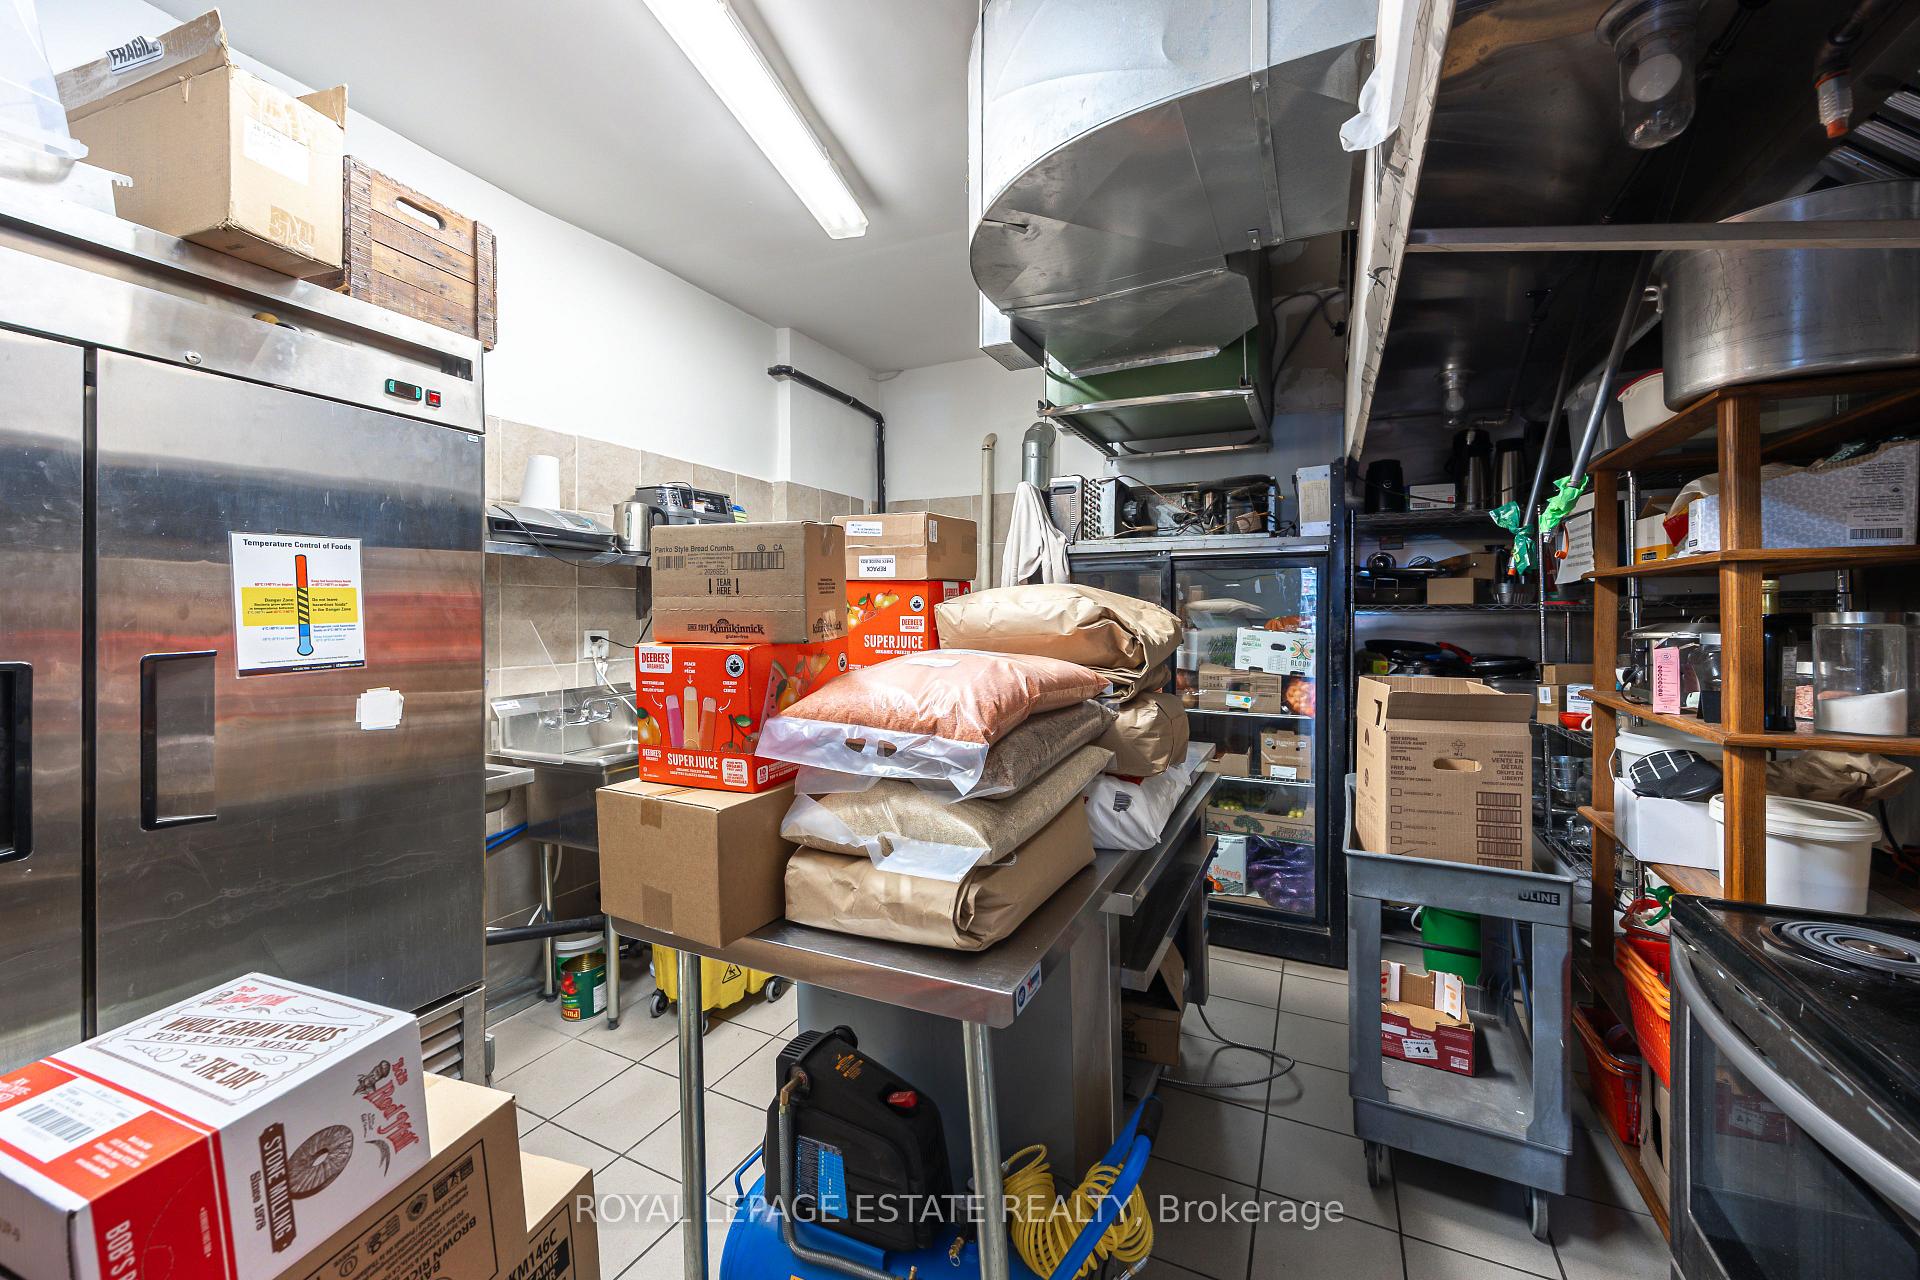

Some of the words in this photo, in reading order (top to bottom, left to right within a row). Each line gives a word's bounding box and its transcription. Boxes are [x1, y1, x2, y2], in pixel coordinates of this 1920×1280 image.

[243, 539, 292, 548] Temperature
[294, 541, 321, 549] Control
[322, 542, 330, 550] of
[674, 546, 689, 554] Style
[710, 544, 734, 552] Crumbs
[717, 578, 731, 586] TEAR
[717, 587, 731, 595] HERE
[710, 624, 764, 635] kinnikinnick
[864, 635, 923, 649] SUPERJUICE
[641, 652, 670, 664] DEEBEES
[667, 753, 719, 770] SUPERJUICE
[1521, 891, 1559, 904] ULINE
[162, 1016, 228, 1036] WHOLE
[217, 1019, 287, 1041] GRAIN
[278, 1025, 347, 1043] FOODS
[147, 1031, 183, 1042] FOR
[186, 1035, 253, 1047] EVERY
[260, 1041, 310, 1052] MEAL
[1415, 1046, 1430, 1054] 14
[192, 1057, 236, 1081] THE
[220, 1066, 268, 1091] DAY
[264, 1135, 286, 1179] STONE
[250, 1170, 262, 1203] Since
[270, 1180, 293, 1241] MILLING
[105, 1219, 135, 1276] BOB'S
[433, 1216, 477, 1262] BROWN
[508, 1228, 558, 1280] KM146C
[531, 1250, 559, 1280] AME
